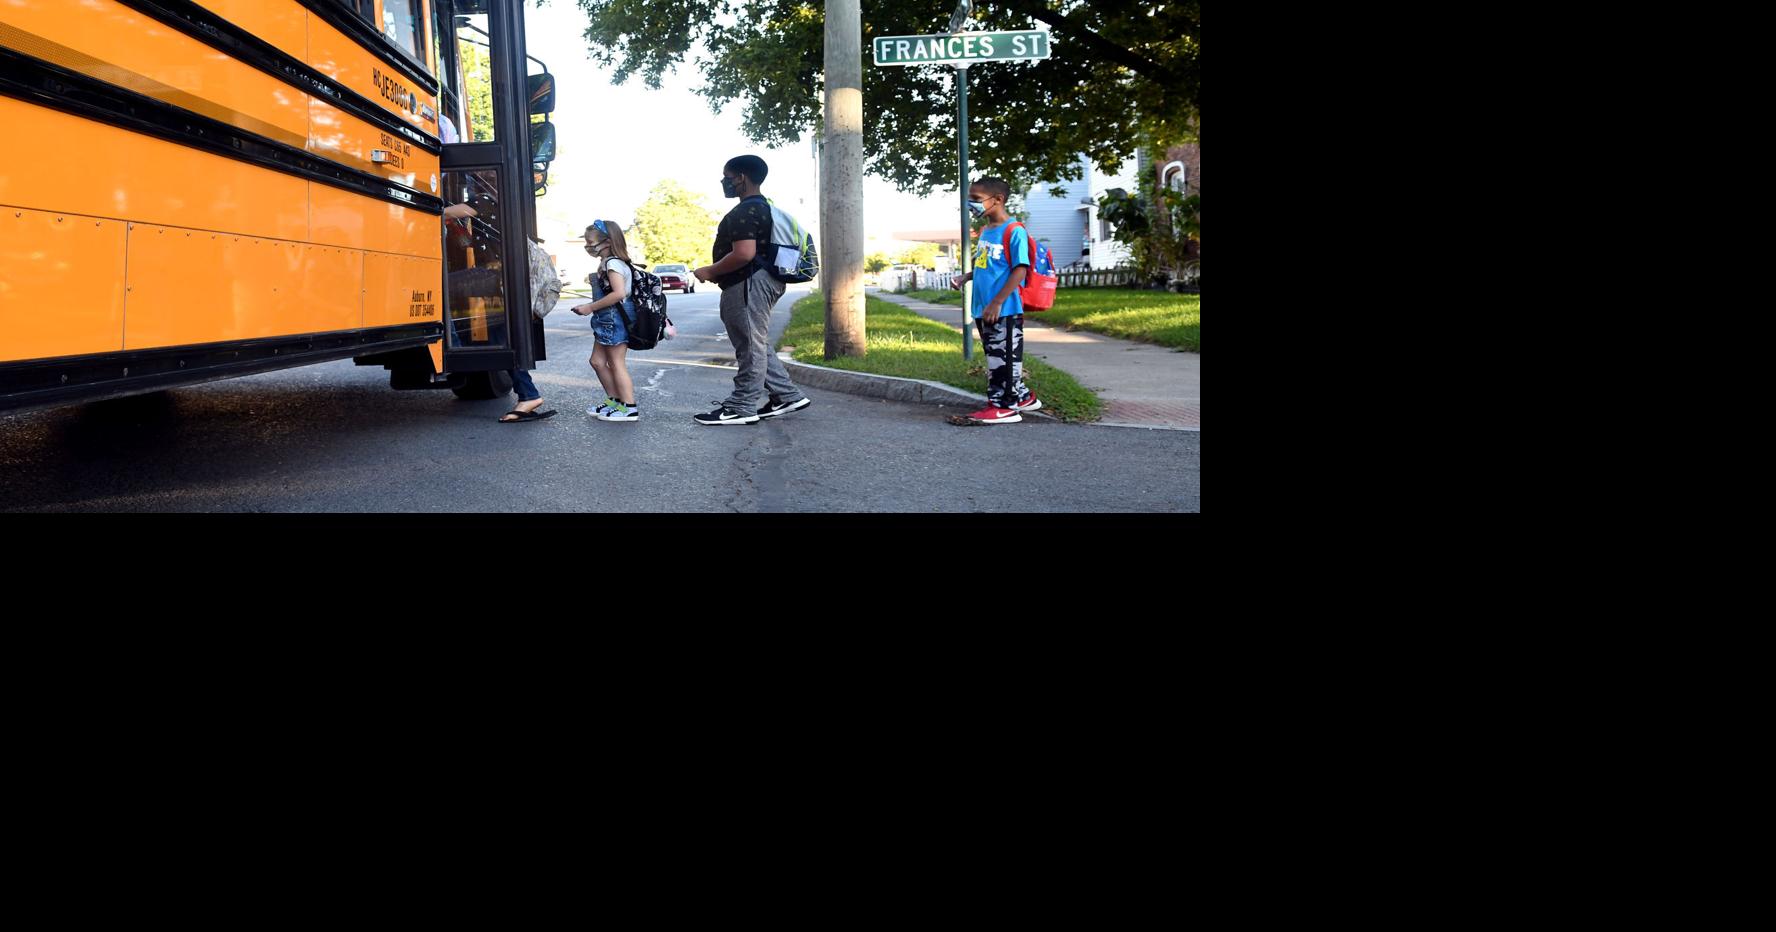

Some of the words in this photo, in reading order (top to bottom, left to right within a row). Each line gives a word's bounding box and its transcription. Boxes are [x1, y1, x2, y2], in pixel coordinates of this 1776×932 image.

[881, 36, 994, 61] FRANCES
[1012, 34, 1042, 56] ST
[380, 132, 393, 149] SEATS
[427, 290, 432, 302] NY
